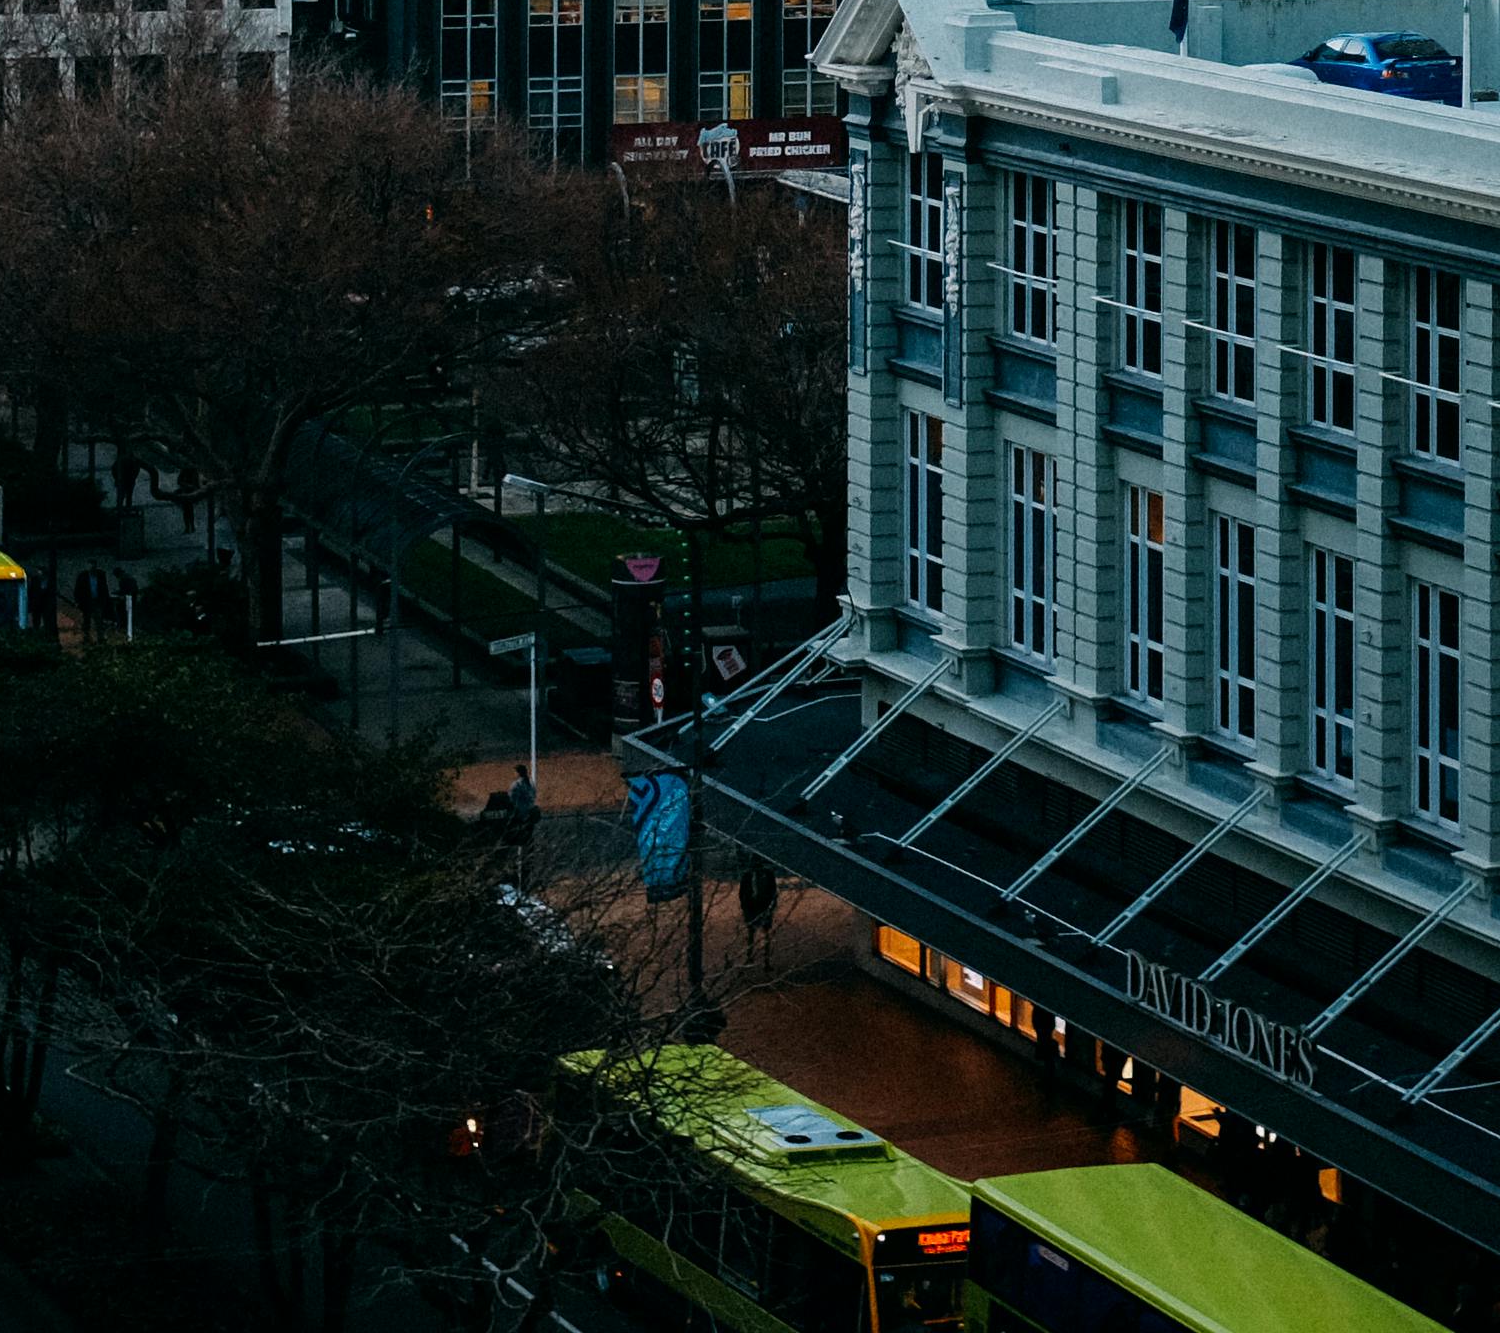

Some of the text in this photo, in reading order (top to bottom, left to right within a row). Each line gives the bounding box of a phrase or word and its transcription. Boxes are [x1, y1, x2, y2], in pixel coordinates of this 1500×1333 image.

[768, 130, 812, 143] MR BUN
[784, 143, 831, 156] CHICKEN
[1126, 949, 1316, 1089] DAVID JONES
